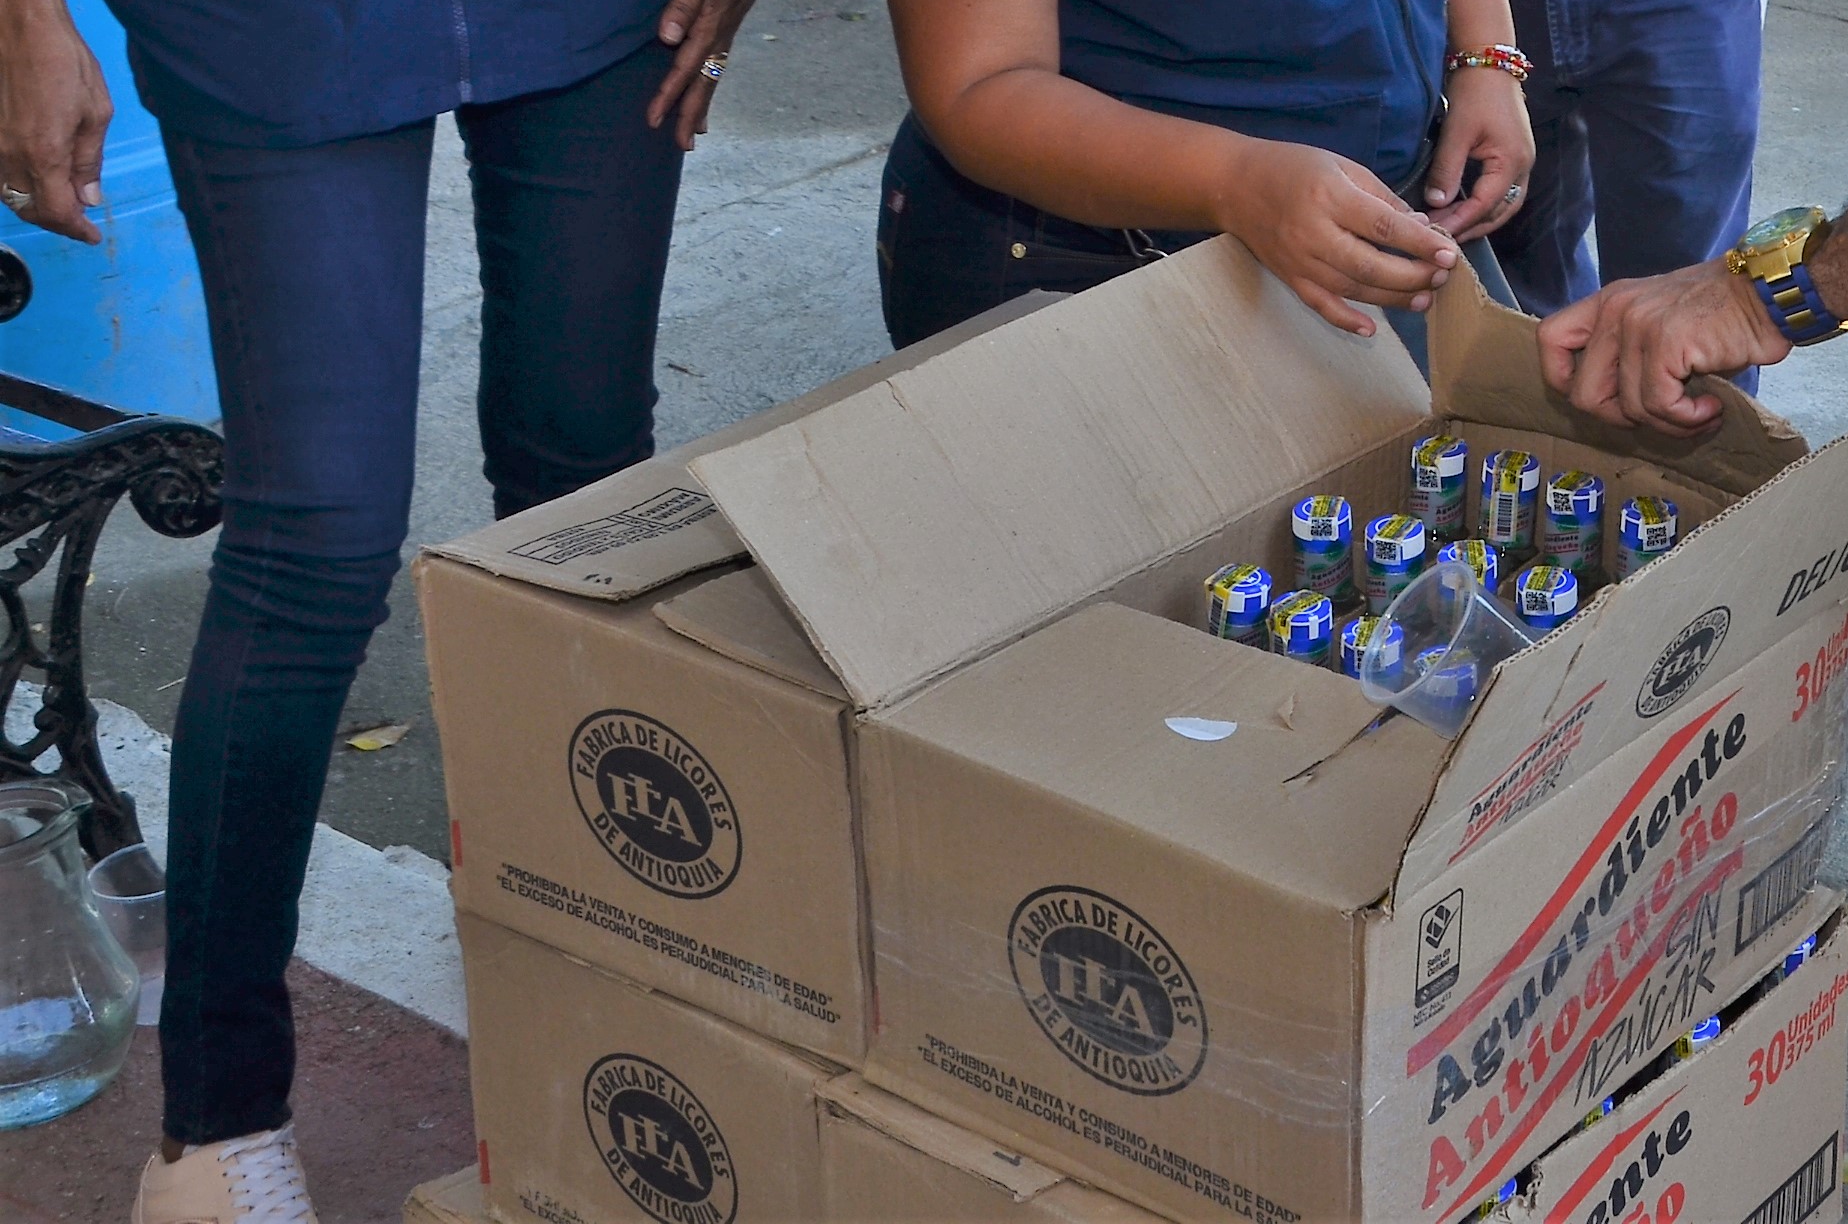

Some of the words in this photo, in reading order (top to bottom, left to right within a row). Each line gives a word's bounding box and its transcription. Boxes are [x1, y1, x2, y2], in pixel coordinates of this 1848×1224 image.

[1791, 646, 1826, 723] 30
[577, 722, 632, 779] FABRICA
[635, 724, 659, 752] DE
[664, 739, 732, 831] LICORES
[1468, 701, 1594, 824] Aguardiente
[593, 811, 620, 845] DE
[619, 841, 724, 888] ANTIOQUIA
[518, 885, 566, 912] EXCESO
[567, 902, 584, 919] DE
[585, 911, 643, 945] ALCOHOL
[643, 935, 659, 951] ES
[660, 942, 739, 984] PERJUDICIAL
[571, 889, 588, 907] LA
[589, 895, 627, 923] VENTA
[628, 912, 638, 926] Y
[638, 916, 699, 952] CONSUMO
[700, 943, 711, 957] A
[711, 947, 773, 983] MENORES
[774, 972, 792, 989] DE
[1018, 898, 1087, 958] FABRICA
[1092, 903, 1118, 936] DE
[1124, 922, 1197, 1027] LICORES
[1428, 713, 1746, 1124] Aguardiente
[1666, 876, 1727, 979] SIN
[1032, 993, 1062, 1029] DE
[1059, 1026, 1183, 1085] ANTIOQUIA
[1421, 791, 1738, 1210] Antioqueño
[1785, 1026, 1815, 1071] 375
[1818, 1002, 1836, 1041] ml
[1744, 1030, 1786, 1106] 30
[591, 1065, 642, 1116] FABRICA
[644, 1069, 666, 1096] DE
[671, 1086, 731, 1179] LICORES
[941, 1058, 992, 1093] EXCESO
[995, 1085, 1014, 1104] DE
[1016, 1097, 1081, 1136] ALCOHOL
[1083, 1126, 1102, 1145] ES
[1104, 1135, 1194, 1189] PERJUDICIAL
[1195, 1180, 1232, 1210] PARA
[1235, 1201, 1253, 1221] LA
[1001, 1071, 1018, 1090] LA
[1021, 1081, 1064, 1113] VENTA
[1066, 1102, 1076, 1116] Y
[1078, 1108, 1148, 1151] CONSUMO
[1150, 1143, 1161, 1158] A
[1163, 1148, 1230, 1192] MENORES
[1233, 1184, 1253, 1203] DE
[606, 1147, 630, 1179] DE
[629, 1177, 723, 1224] ANTIOQUIA
